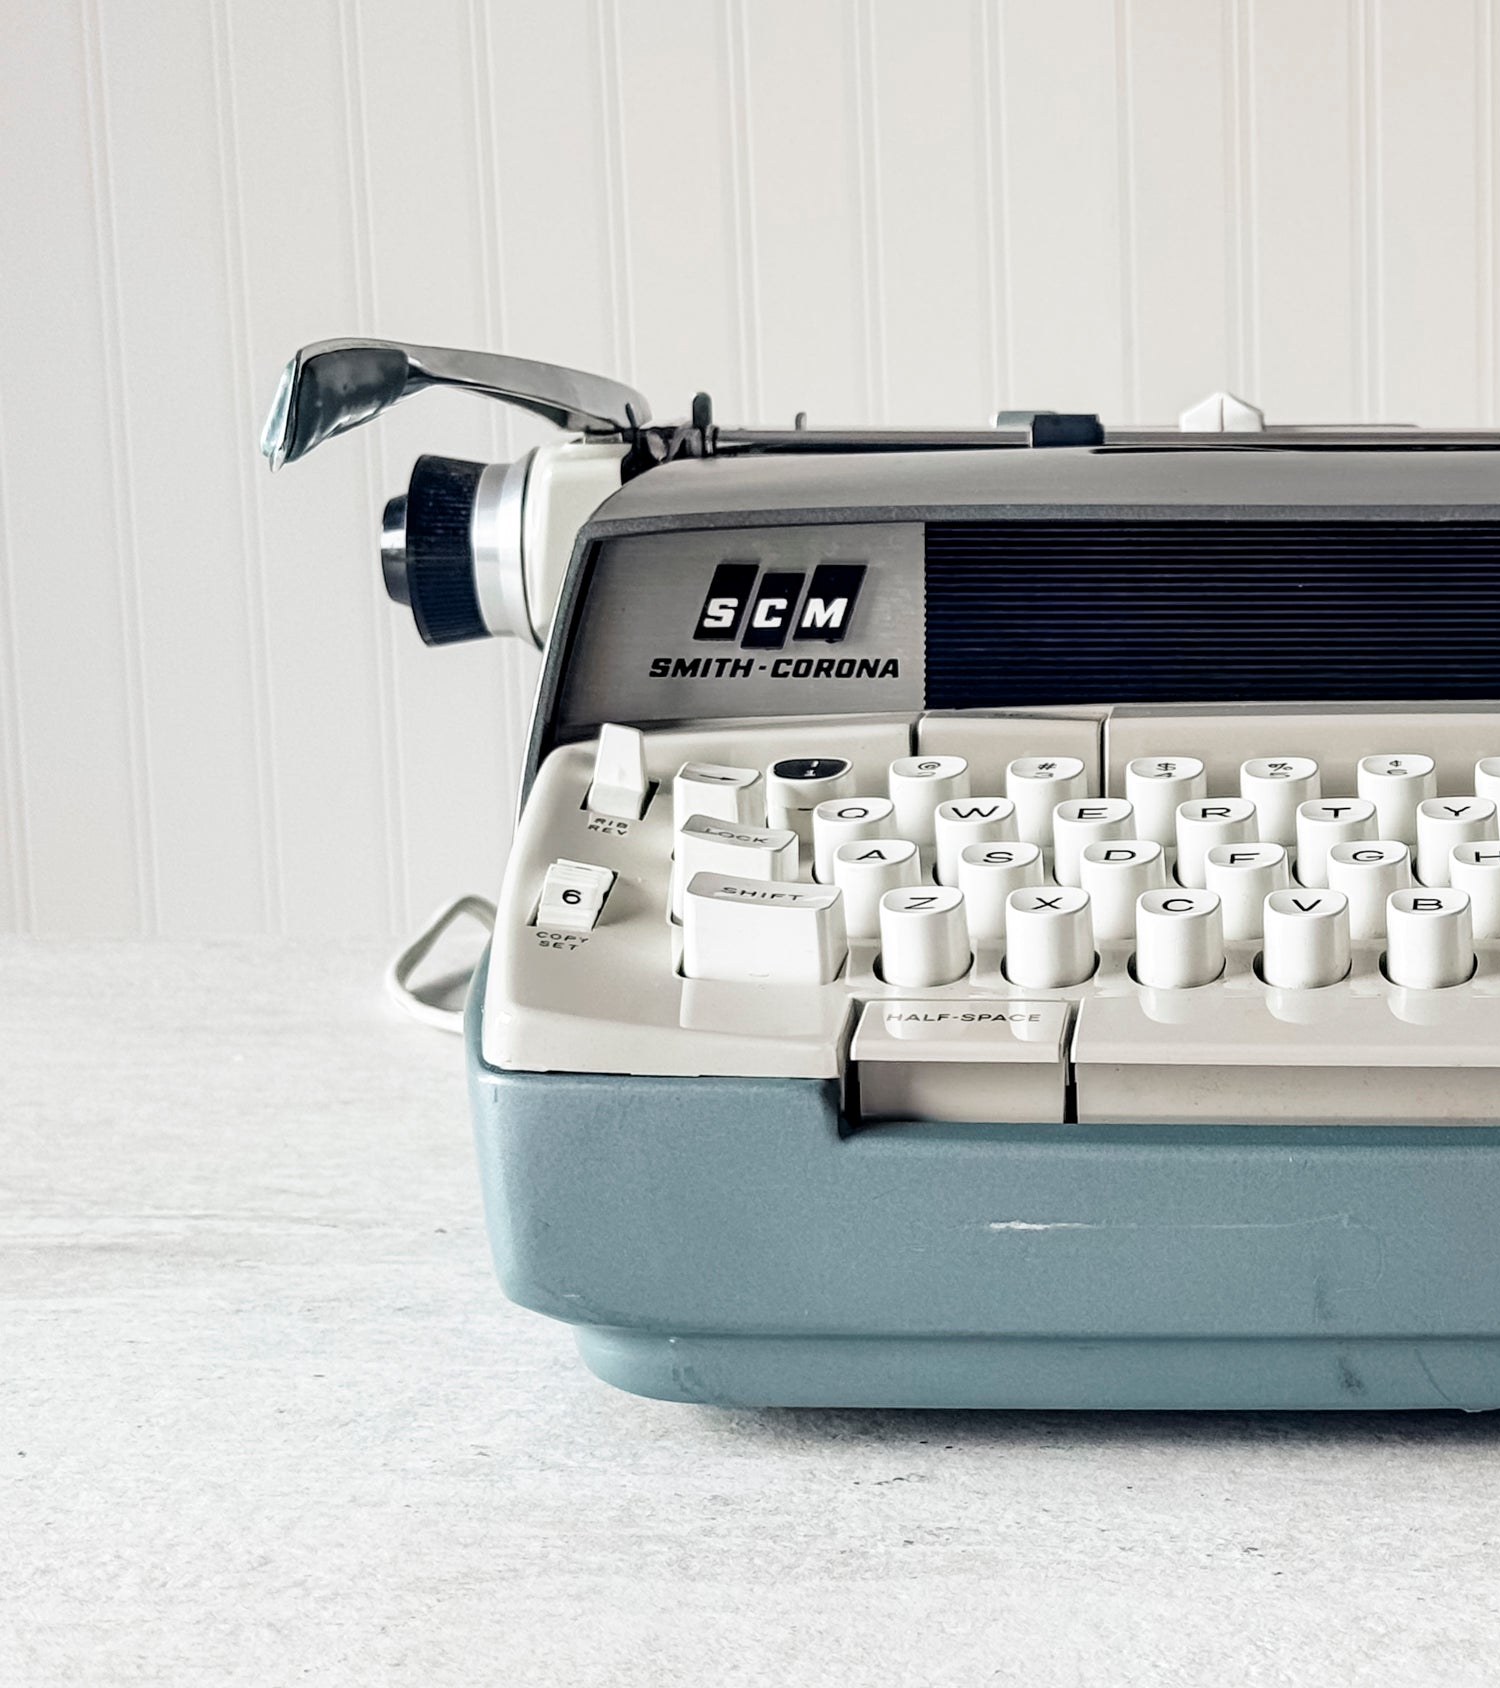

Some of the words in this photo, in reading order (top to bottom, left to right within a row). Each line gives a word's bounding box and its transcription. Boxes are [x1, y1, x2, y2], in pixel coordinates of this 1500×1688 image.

[703, 598, 848, 628] SCM
[918, 761, 941, 771] @
[1037, 761, 1058, 770] #
[1157, 762, 1177, 772] $
[1268, 762, 1293, 771] %
[838, 807, 869, 819] Q
[951, 805, 1000, 820] W
[1077, 807, 1109, 820] E
[1200, 807, 1232, 819] R
[1321, 807, 1352, 819] T
[1443, 805, 1471, 818] Y
[588, 823, 628, 836] REV
[703, 826, 769, 845] LOCK
[856, 849, 887, 861] A
[982, 851, 1015, 864] S
[1103, 849, 1137, 861] D
[1229, 852, 1261, 864] F
[1351, 850, 1385, 862] G
[561, 888, 583, 906] 6
[720, 886, 805, 902] SHIFT
[904, 897, 938, 910] Z
[1032, 897, 1063, 910] X
[1162, 898, 1194, 912] C
[1291, 898, 1322, 912] V
[1412, 898, 1444, 911] B
[535, 930, 590, 944] COPY
[538, 939, 579, 951] SET
[887, 1013, 1041, 1022] HALF-SPACE
